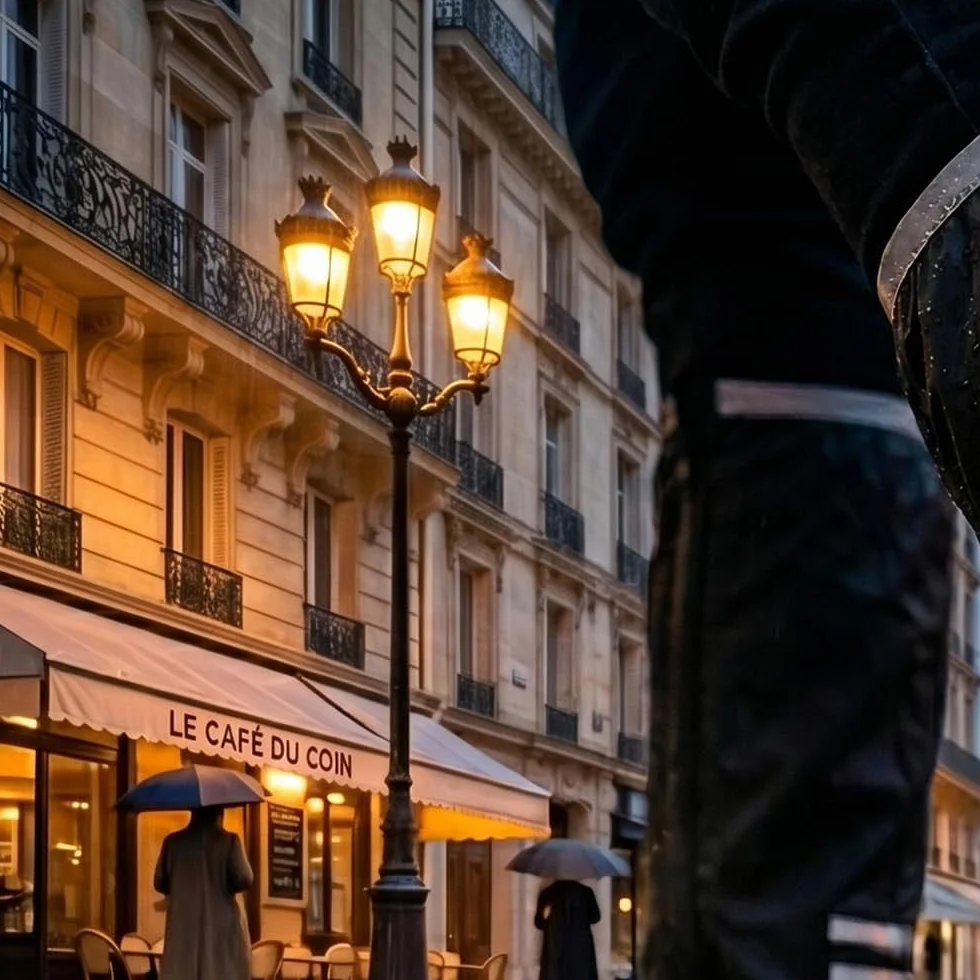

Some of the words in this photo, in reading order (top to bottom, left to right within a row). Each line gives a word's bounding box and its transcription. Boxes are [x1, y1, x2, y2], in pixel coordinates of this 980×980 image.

[169, 709, 197, 741] LE
[205, 720, 264, 758] CAFÉ
[270, 735, 299, 765] DU
[306, 746, 352, 779] COIN
